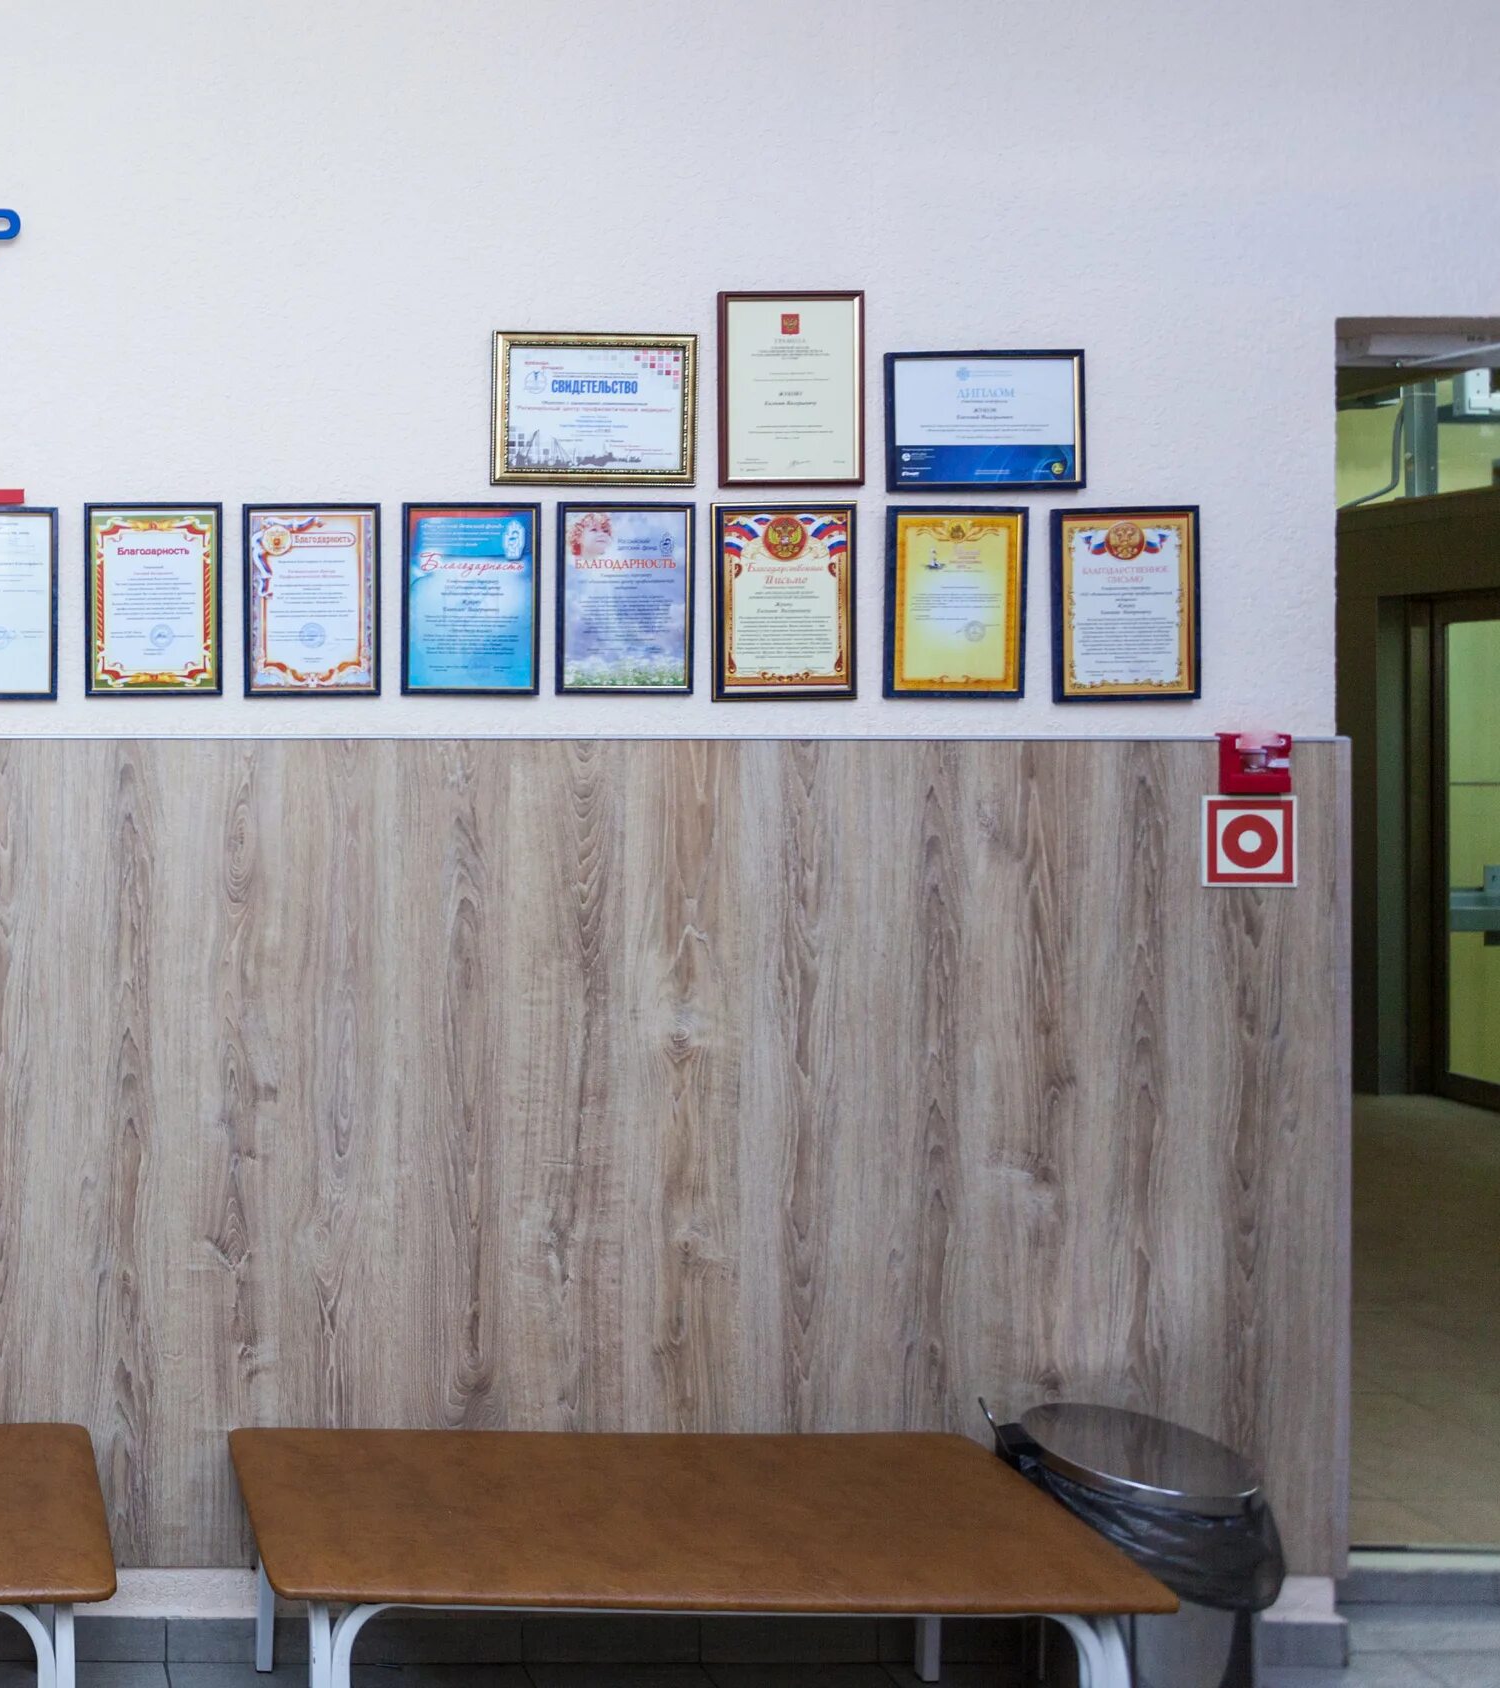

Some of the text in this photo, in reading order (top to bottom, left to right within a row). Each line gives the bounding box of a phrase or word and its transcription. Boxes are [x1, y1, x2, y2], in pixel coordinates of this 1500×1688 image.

[551, 379, 638, 395] СВИДЕТЕЛЬСТВО
[956, 387, 1016, 399] ДИПЛОМ
[294, 534, 352, 544] Благодарность
[117, 547, 190, 556] Благодарность
[420, 551, 524, 577] Благодарность
[575, 557, 677, 570] БЛАГОДАРНОСТЬ
[1082, 565, 1170, 576] БЛАГОДАРСТВЕННОЕ
[1107, 575, 1144, 584] ПИСЬМО
